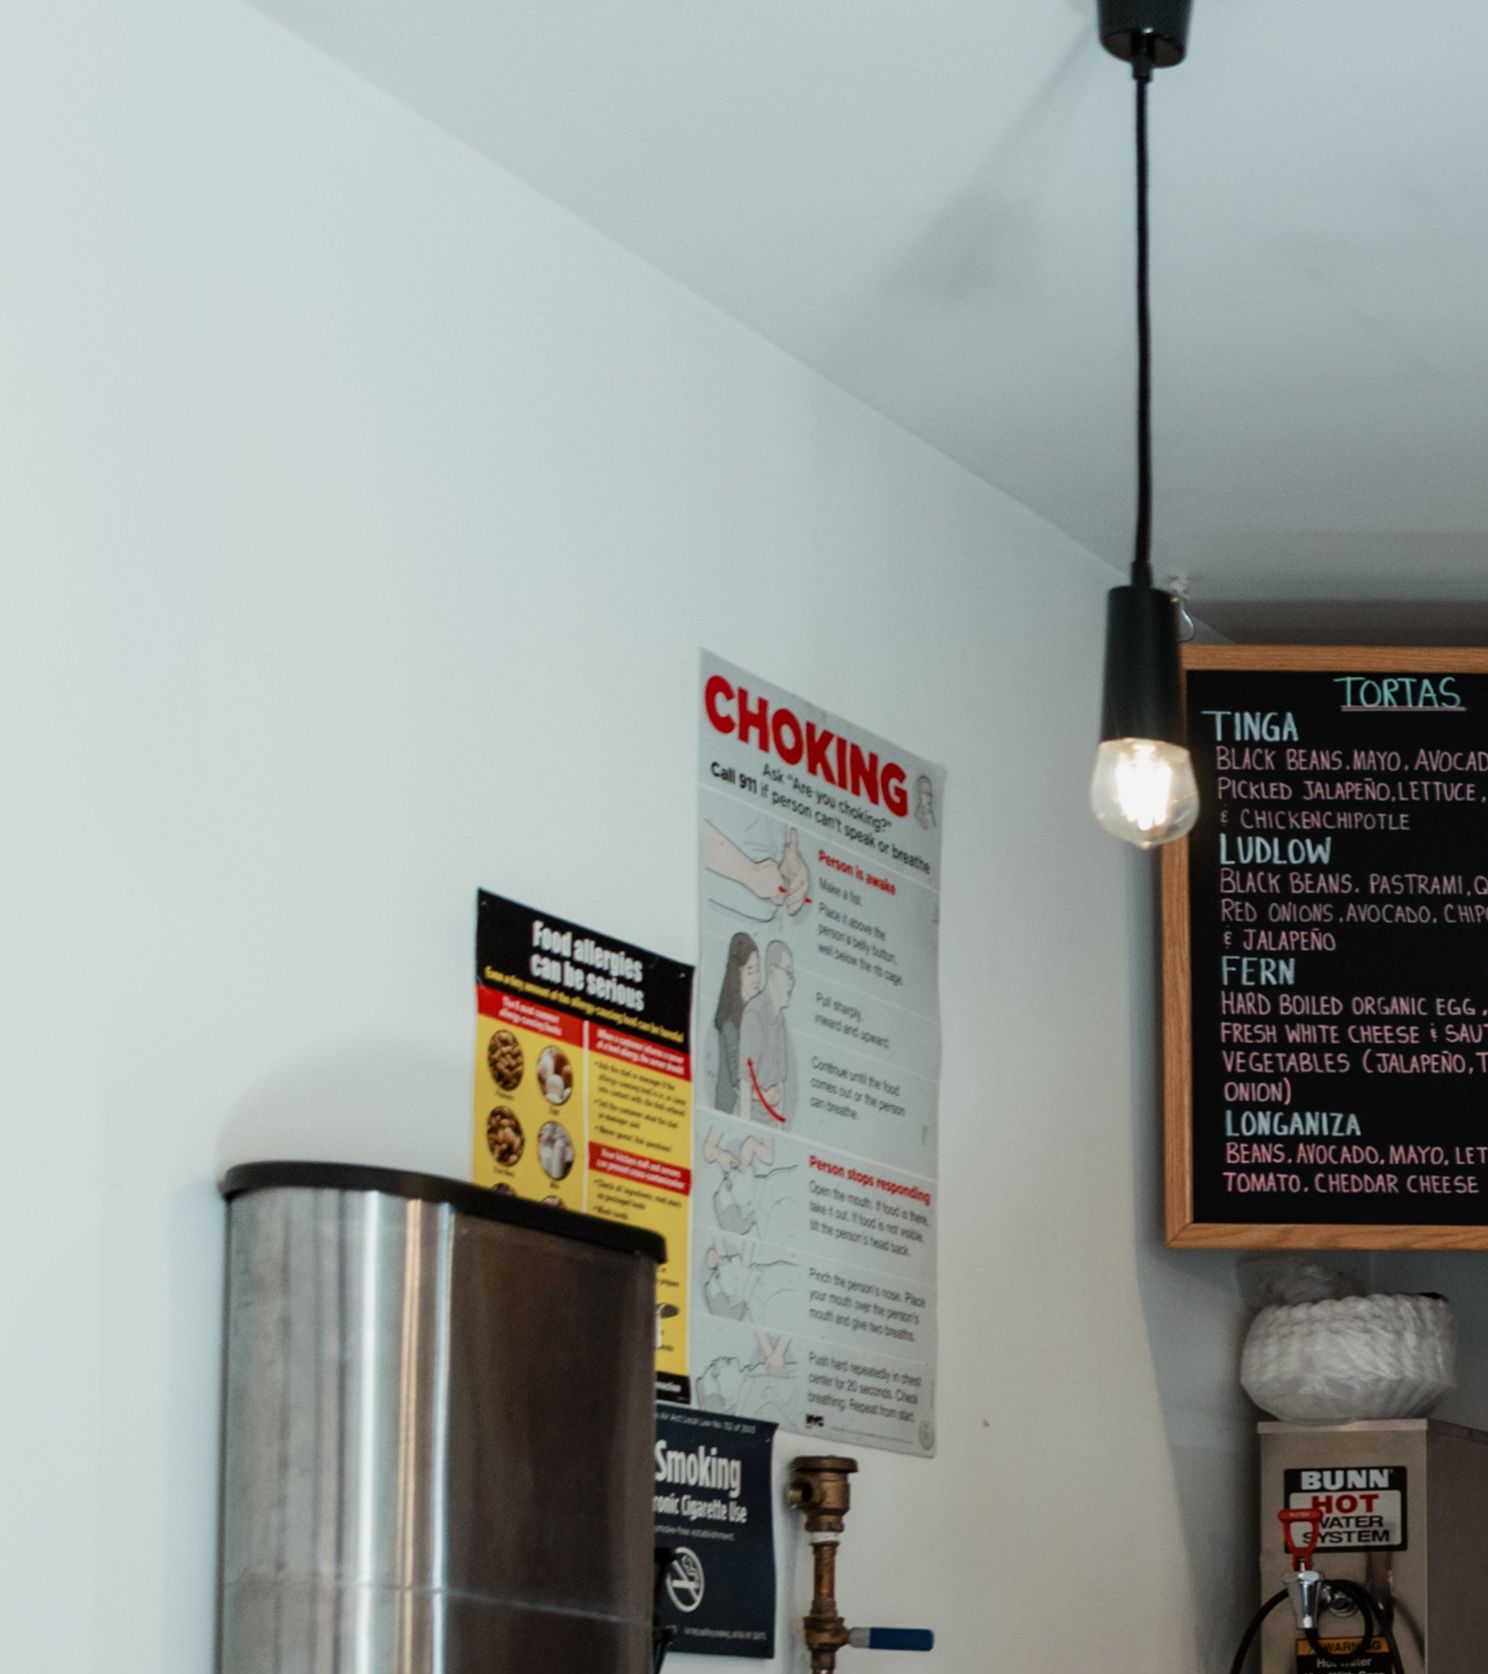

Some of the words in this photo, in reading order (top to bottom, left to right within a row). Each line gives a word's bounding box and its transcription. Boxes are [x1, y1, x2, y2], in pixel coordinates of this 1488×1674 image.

[1336, 677, 1465, 710] TORTAS
[704, 675, 909, 817] CHOKING
[1204, 711, 1298, 747] TINGA
[763, 763, 785, 783] Ask
[814, 786, 836, 810] you
[711, 762, 736, 784] Call
[739, 773, 757, 794] 911
[761, 781, 769, 799] if
[772, 789, 812, 822] person
[844, 823, 876, 851] speak
[879, 836, 890, 852] or
[891, 843, 930, 875] breathe
[1221, 834, 1330, 869] LUDLOW
[532, 920, 572, 956] Food
[573, 938, 643, 983] allergies
[530, 954, 561, 984] can
[563, 961, 584, 991] be
[586, 973, 645, 1012] serious
[810, 1154, 846, 1180] Person
[847, 1166, 874, 1186] stops
[876, 1175, 930, 1205] responding
[655, 1440, 742, 1499] Smoking
[1301, 1469, 1389, 1490] BUNN
[681, 1494, 727, 1522] Cigarette
[729, 1505, 748, 1523] Use
[1312, 1494, 1379, 1514] HOT
